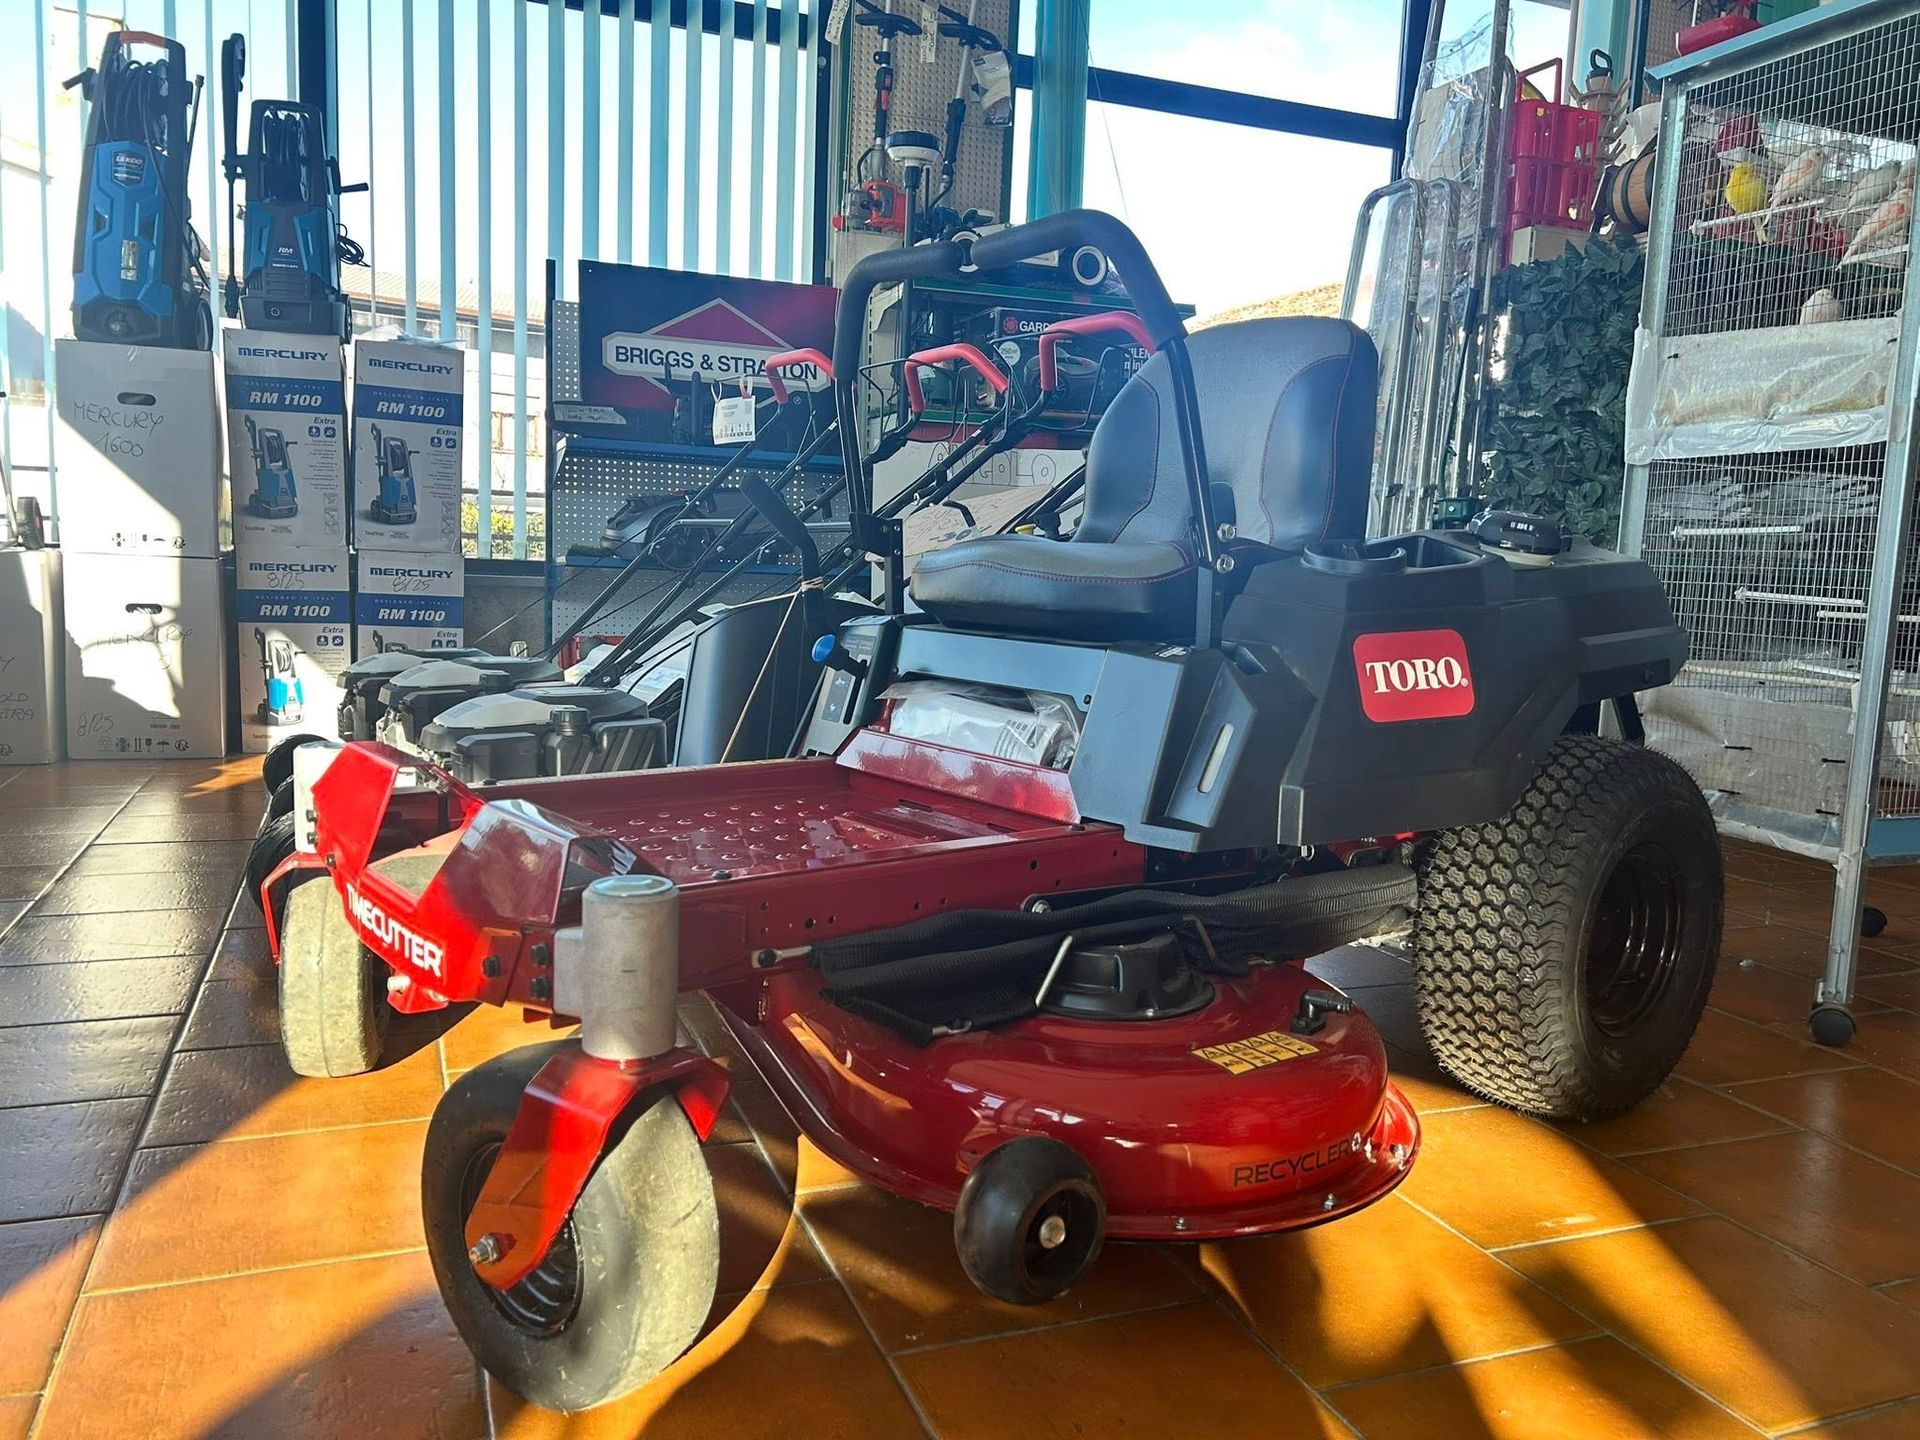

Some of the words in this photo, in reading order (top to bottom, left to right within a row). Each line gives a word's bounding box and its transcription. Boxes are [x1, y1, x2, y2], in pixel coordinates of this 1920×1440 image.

[1019, 320, 1050, 332] GARD
[238, 347, 328, 361] MERCURY
[368, 358, 454, 375] MERCURY
[615, 345, 694, 370] BRIGGS
[700, 356, 714, 371] &
[718, 355, 818, 380] STRATON
[249, 391, 279, 404] RM
[283, 393, 322, 407] 1100
[376, 401, 405, 415] RM
[409, 404, 445, 418] 1100
[73, 401, 164, 437] MERCURY
[313, 416, 336, 425] Extra
[436, 427, 457, 436] Extra
[95, 432, 144, 457] 1600
[249, 562, 338, 573] MERCURY
[370, 567, 454, 579] MERCURY
[259, 604, 288, 616] RM
[293, 605, 331, 617] 1100
[378, 608, 406, 620] RM
[410, 609, 446, 621] 1100
[322, 626, 344, 634] Extra
[437, 630, 458, 638] Extra
[346, 882, 443, 978] TIMECUTTER
[1233, 1139, 1351, 1187] RECYCLER
